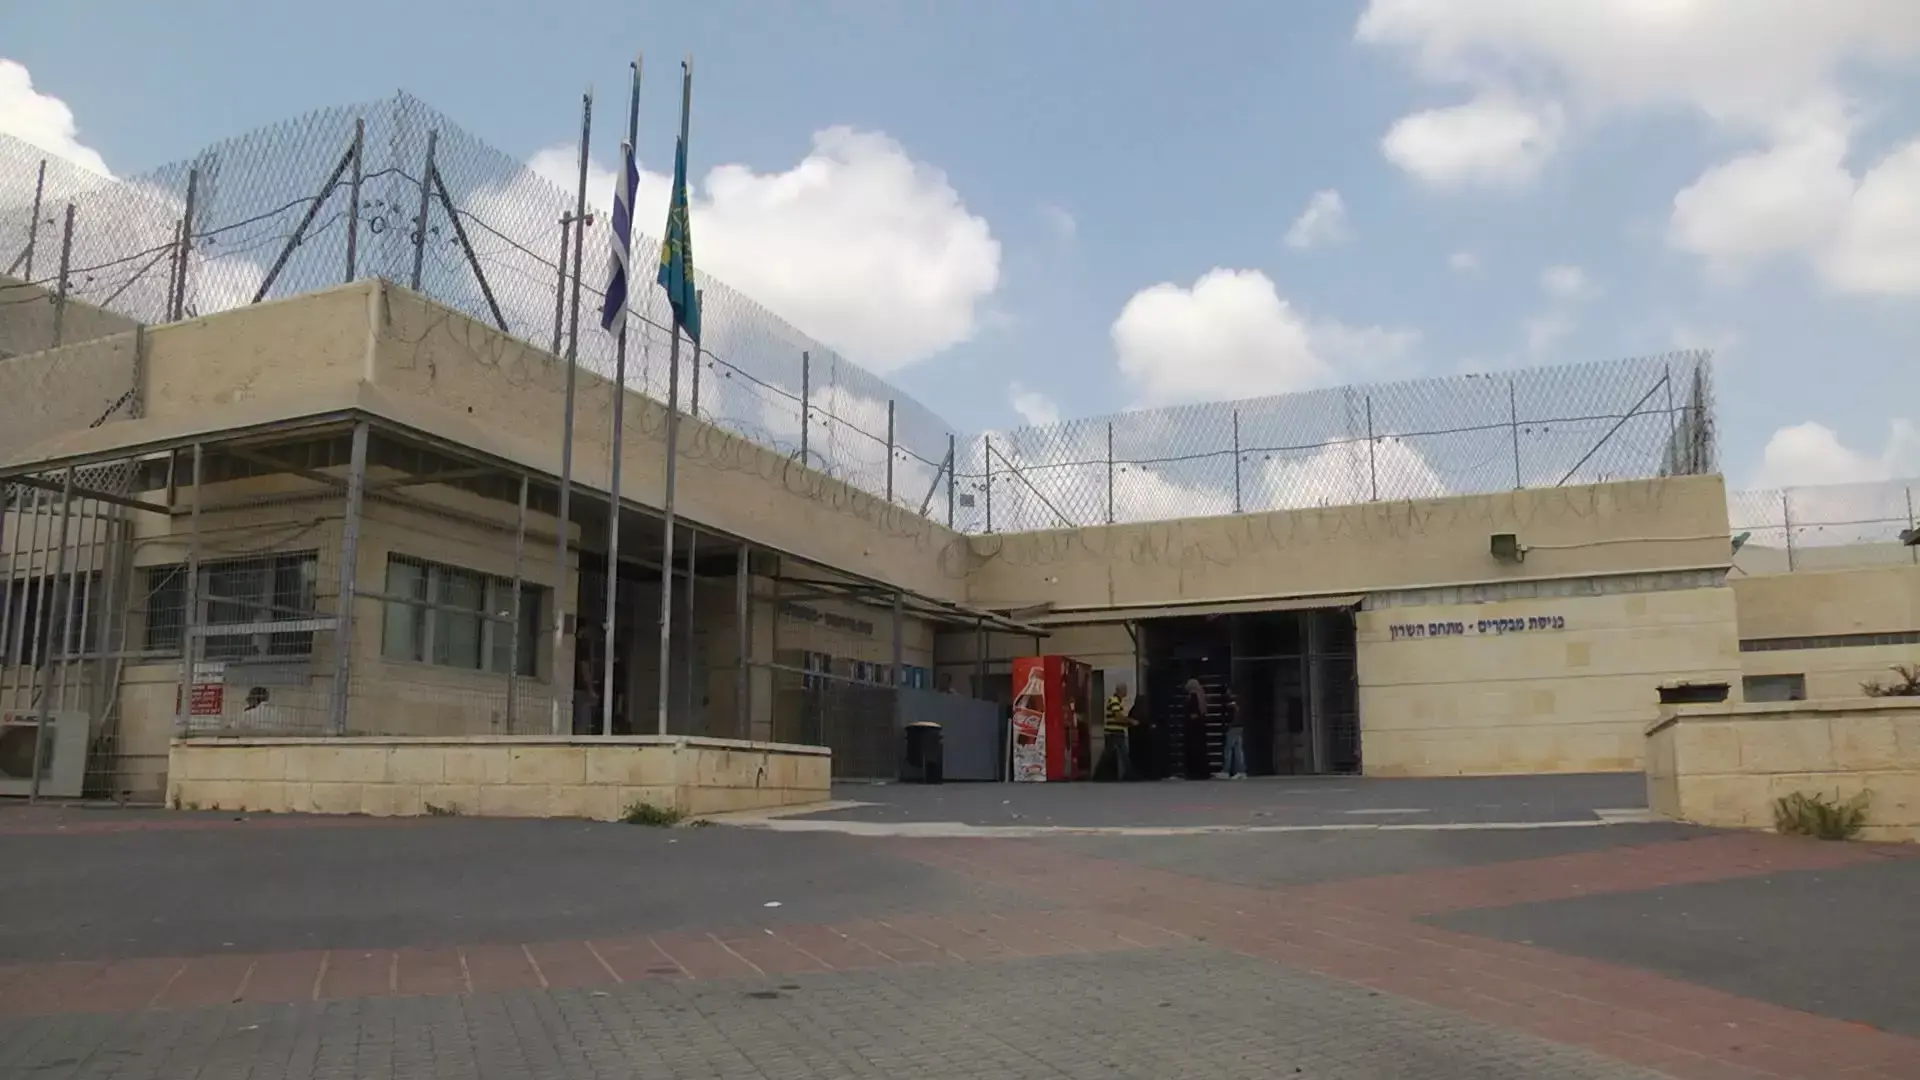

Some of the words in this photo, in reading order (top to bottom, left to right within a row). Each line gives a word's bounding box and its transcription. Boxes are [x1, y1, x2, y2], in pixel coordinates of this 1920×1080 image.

[1428, 622, 1465, 637] מתחם
[1477, 617, 1525, 636] מבקרים
[1528, 615, 1565, 630] כניסת
[1389, 624, 1425, 641] השרון
